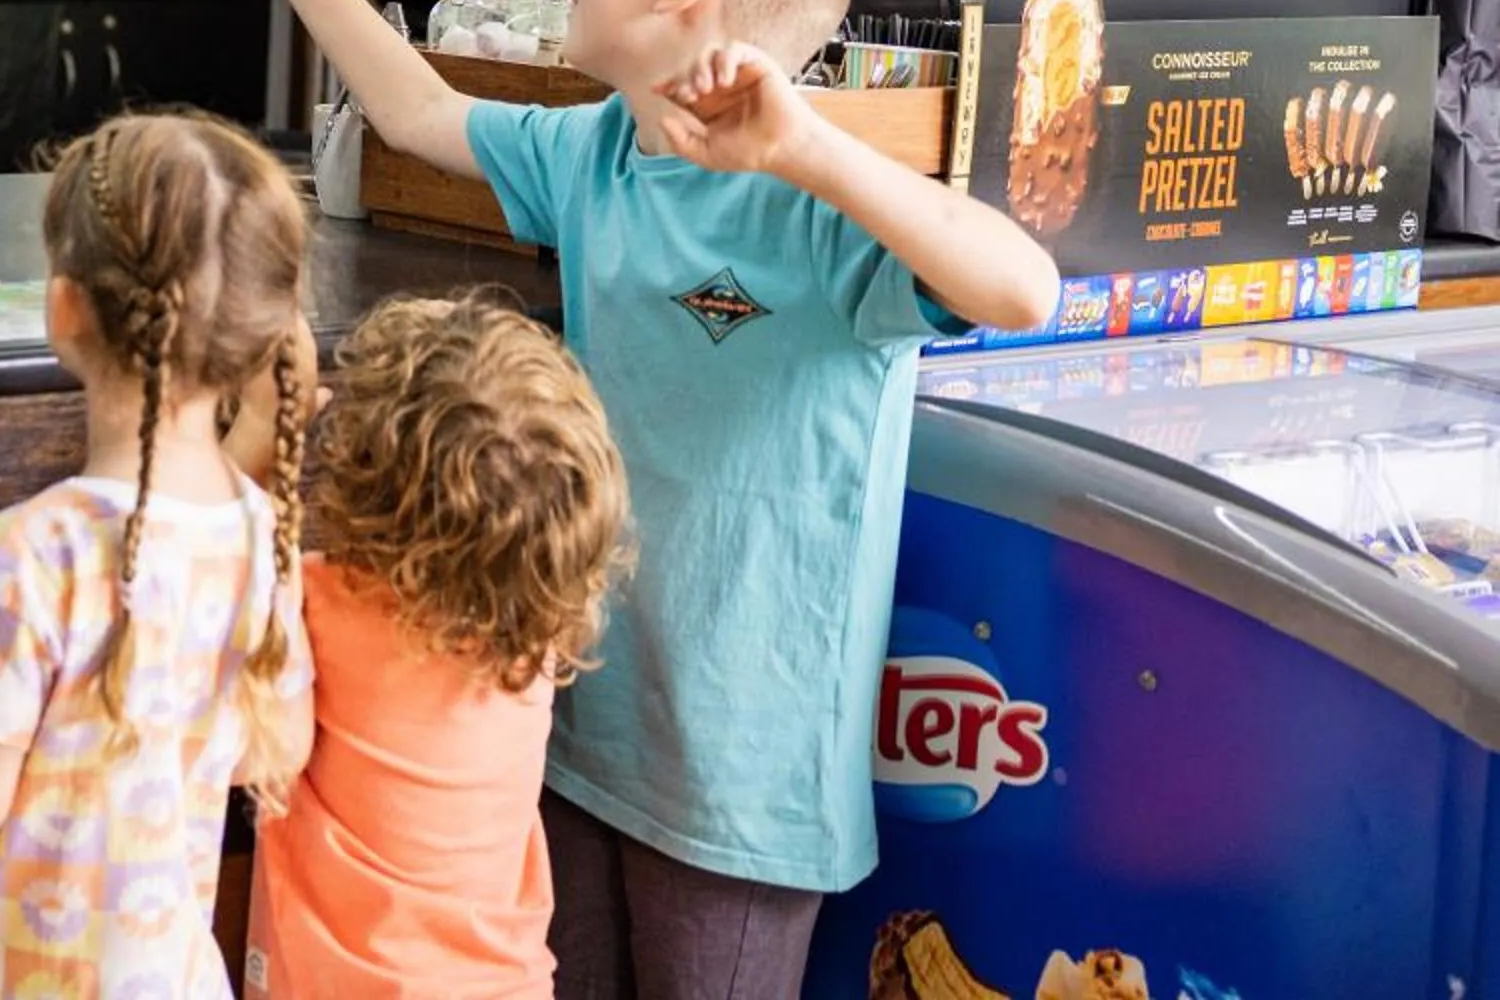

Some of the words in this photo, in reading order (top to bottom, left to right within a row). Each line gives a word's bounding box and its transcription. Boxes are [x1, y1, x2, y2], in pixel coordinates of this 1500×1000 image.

[1152, 52, 1249, 70] CONNOISSEUR
[1327, 58, 1381, 71] COLLECTION
[1145, 98, 1245, 155] SALTED
[1139, 156, 1238, 214] PRETZEL
